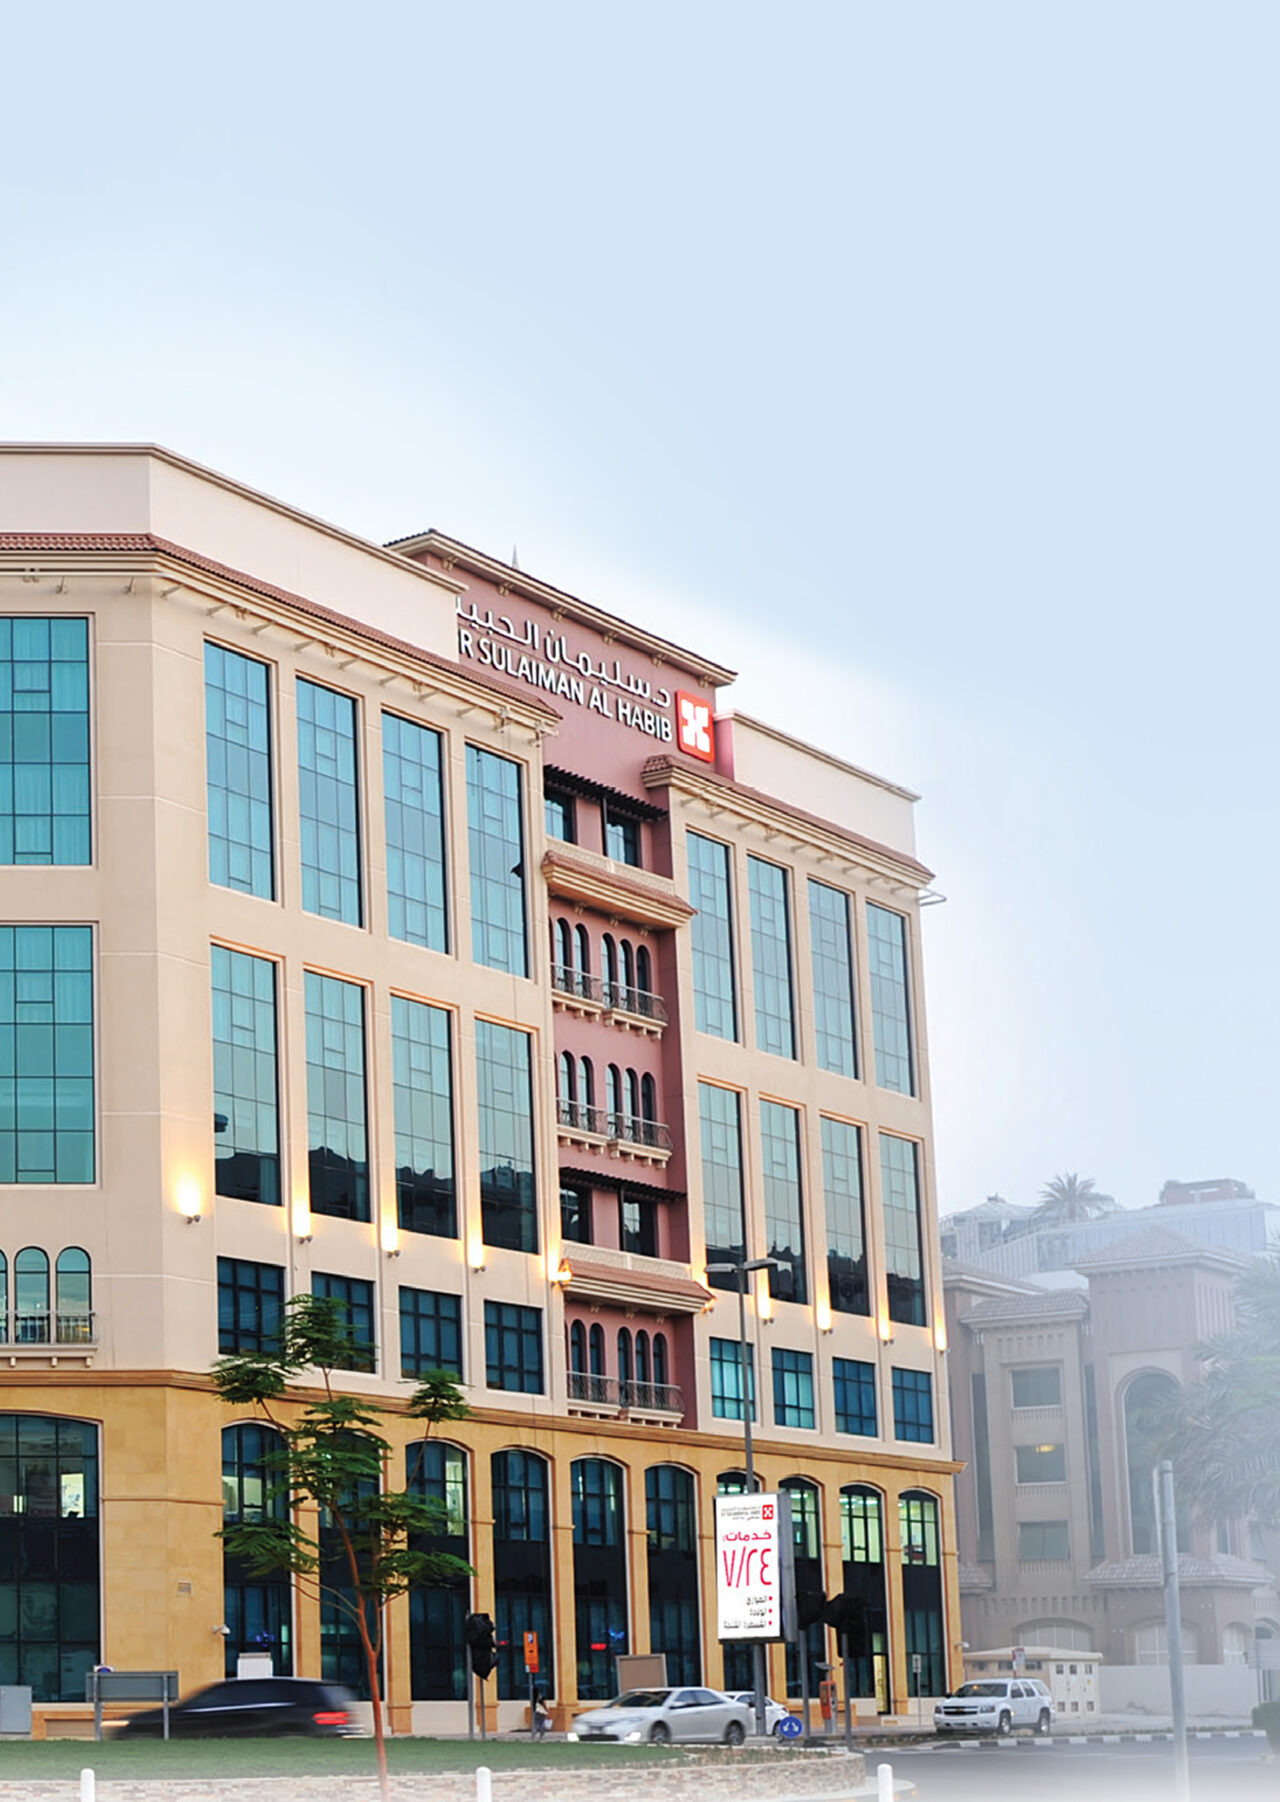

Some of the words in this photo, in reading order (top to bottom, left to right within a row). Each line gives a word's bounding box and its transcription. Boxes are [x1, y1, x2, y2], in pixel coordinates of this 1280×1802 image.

[477, 637, 585, 706] SULAIMAN
[588, 690, 613, 719] AL
[616, 696, 673, 743] HABIB
